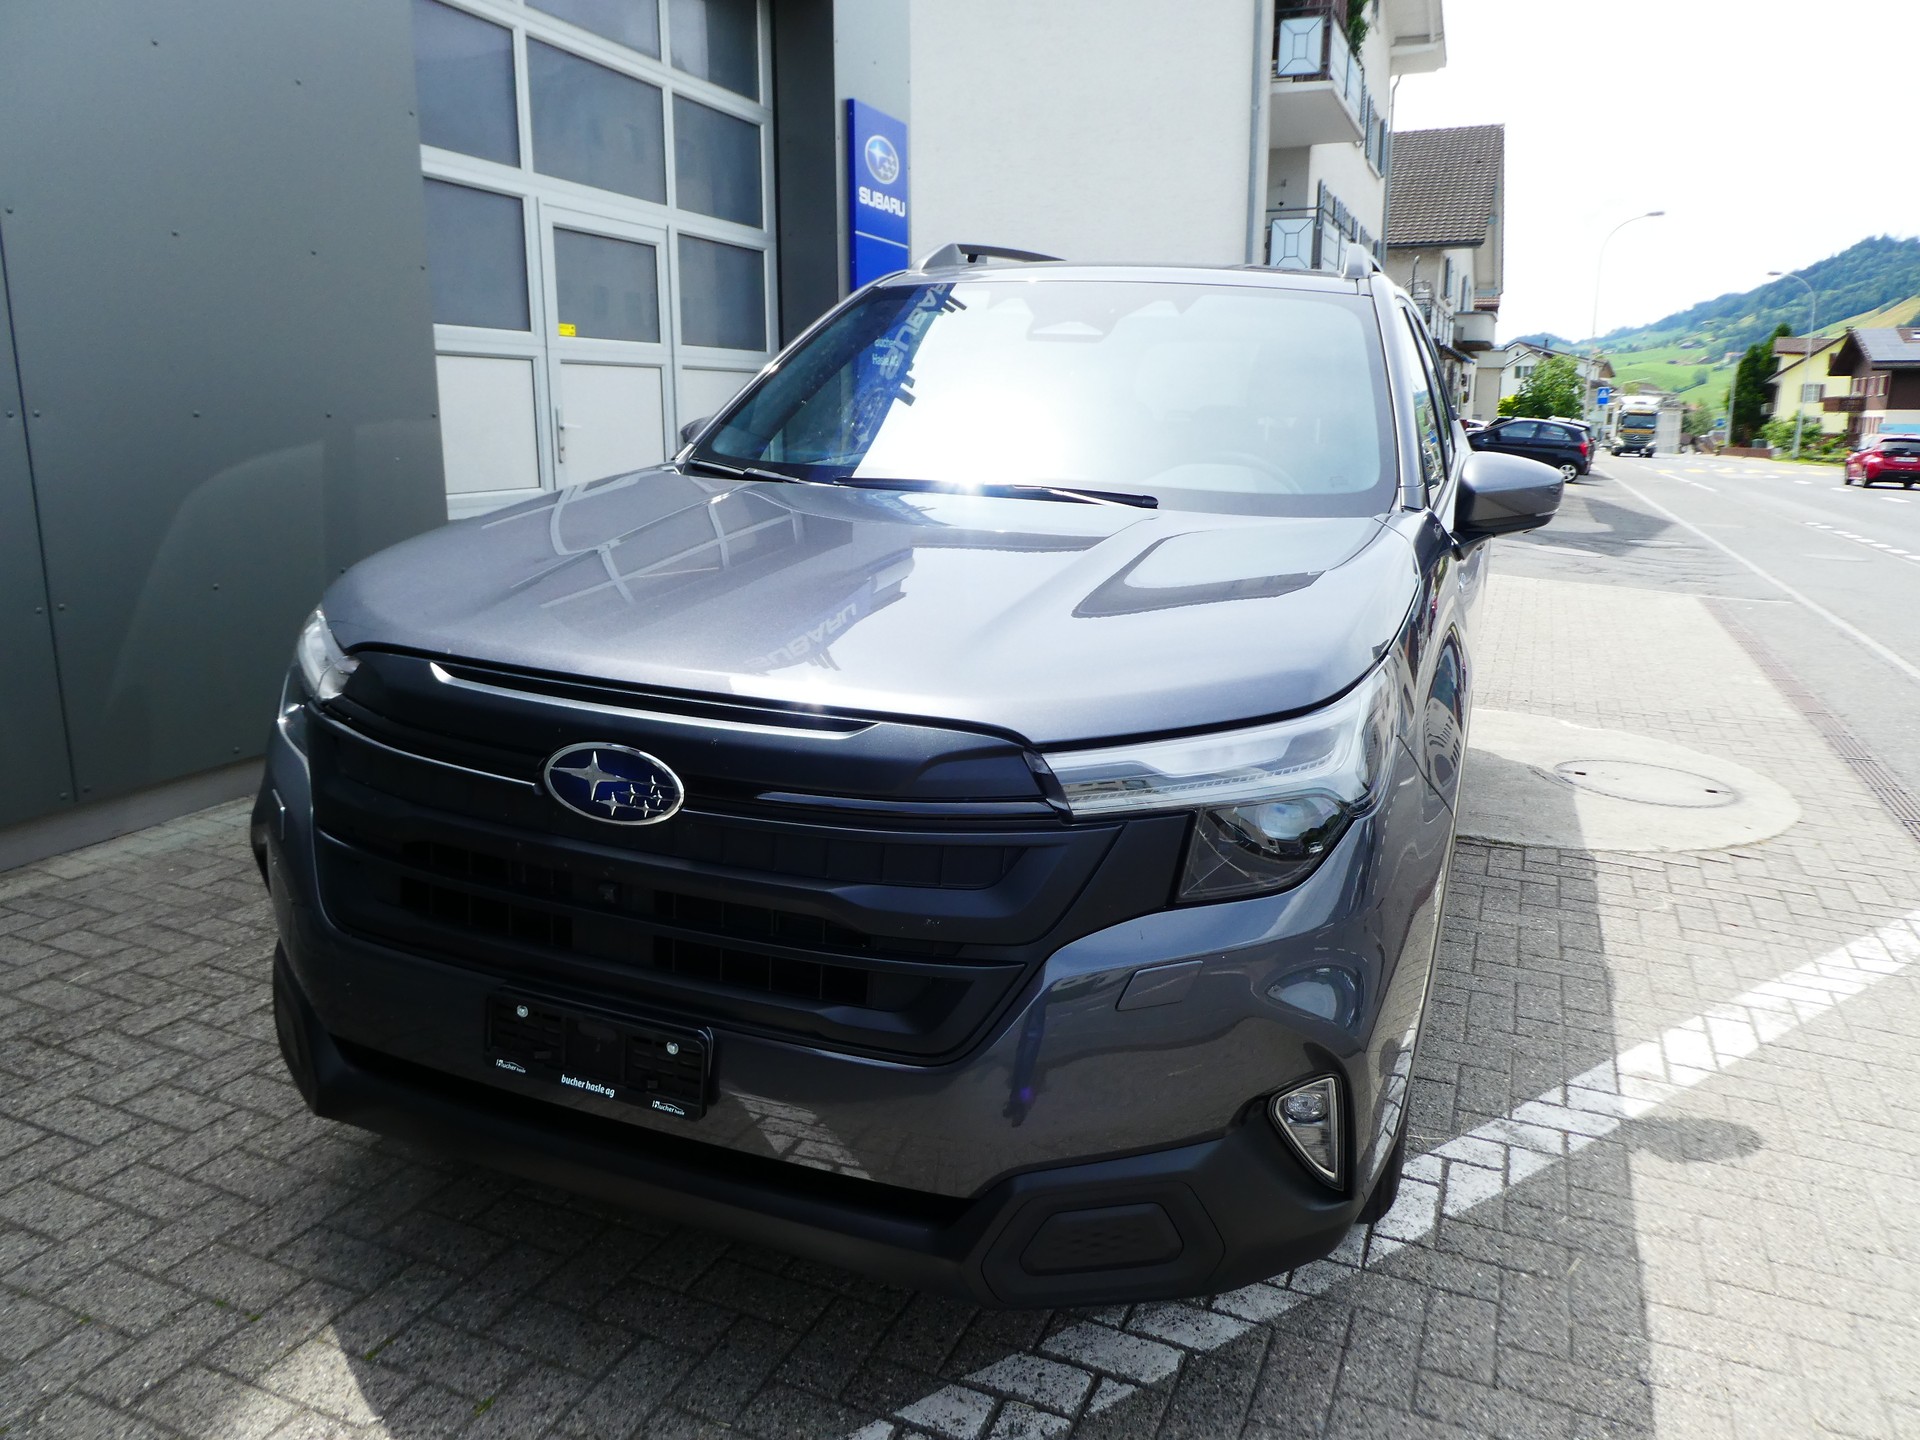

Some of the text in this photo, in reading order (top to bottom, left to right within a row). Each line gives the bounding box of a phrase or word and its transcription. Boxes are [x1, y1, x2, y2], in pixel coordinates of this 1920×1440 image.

[858, 186, 906, 217] SUBARU
[561, 1073, 615, 1098] bucher hasle ag
